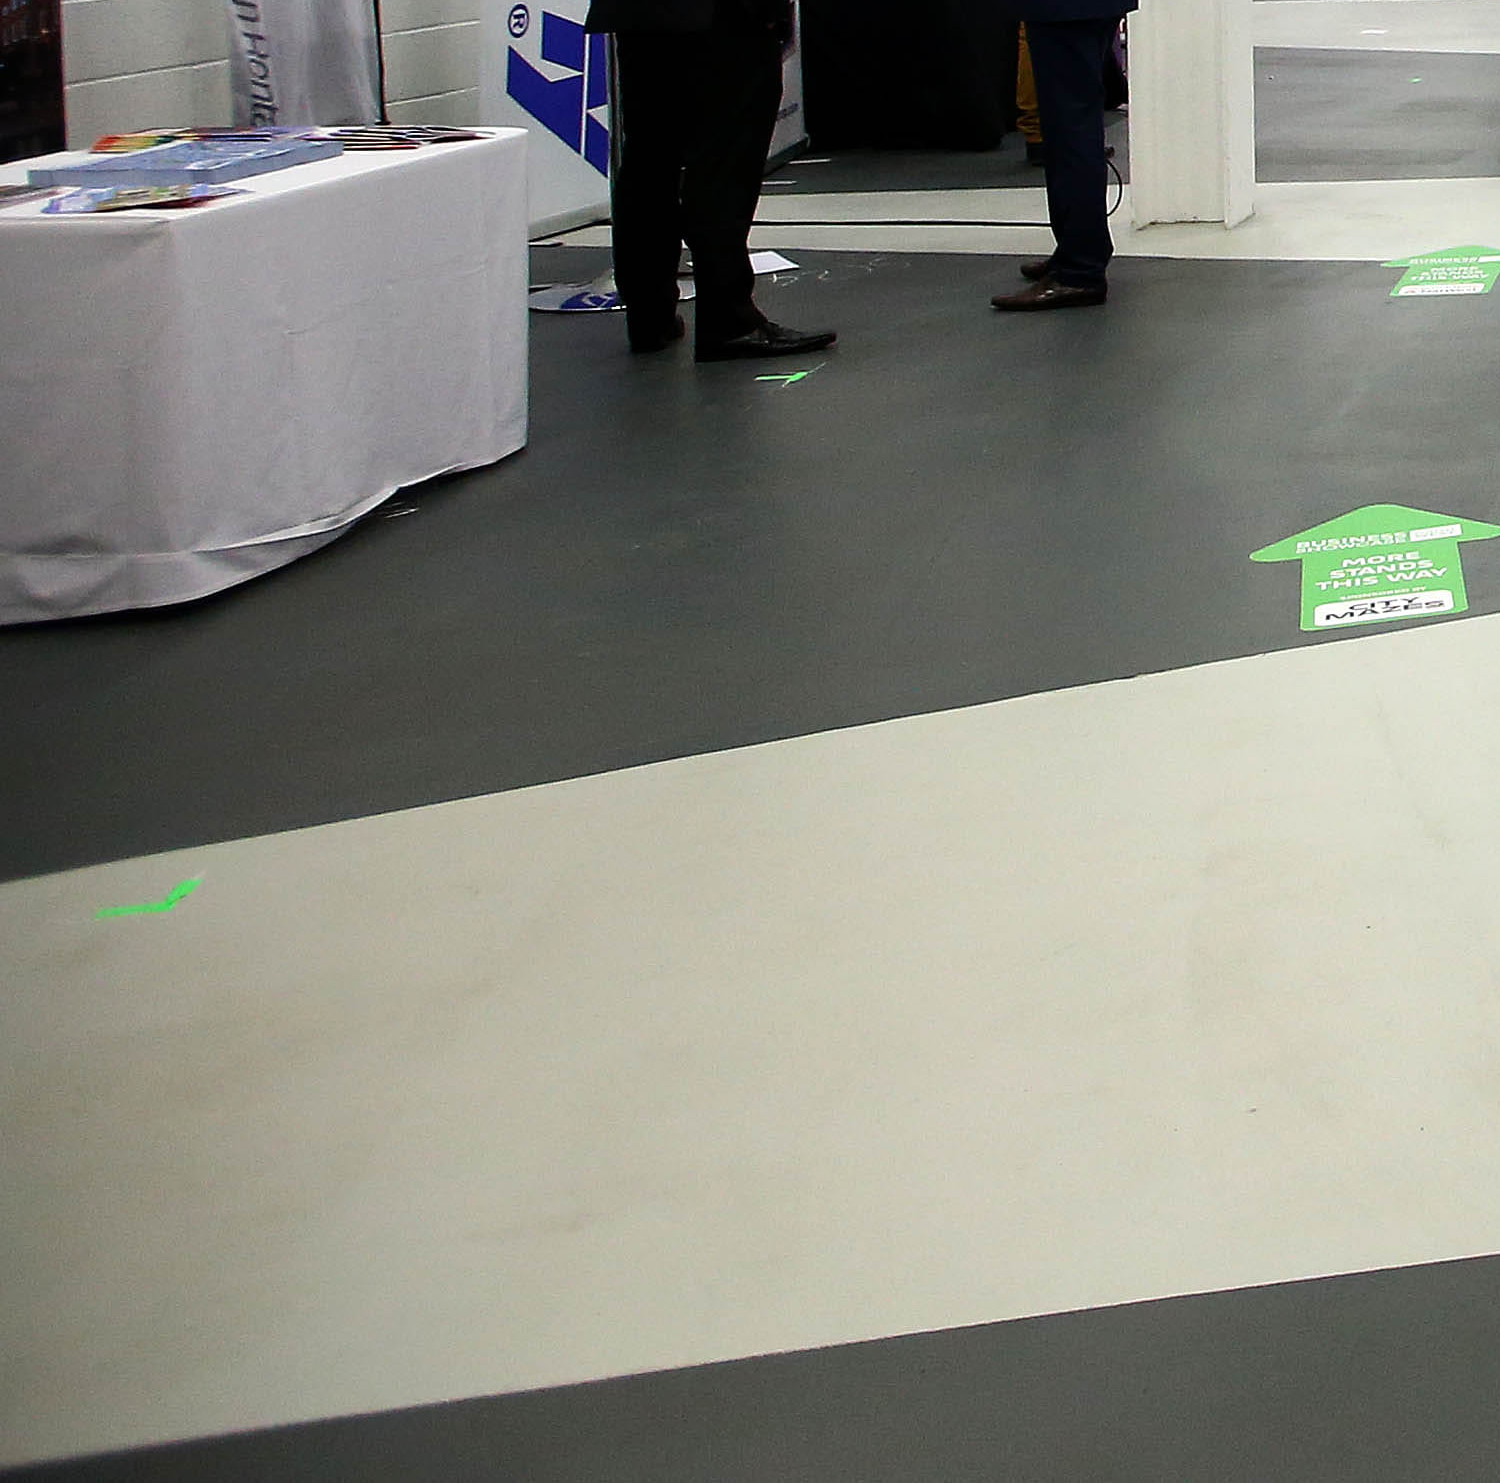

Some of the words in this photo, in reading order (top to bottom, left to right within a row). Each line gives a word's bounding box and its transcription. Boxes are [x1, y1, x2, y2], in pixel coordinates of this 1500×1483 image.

[1296, 532, 1408, 549] BUSINESS
[1341, 551, 1420, 567] MORE
[1329, 560, 1433, 580] STANDS
[1315, 577, 1379, 591] THIS
[1386, 568, 1449, 584] WAY
[1325, 600, 1446, 621] MAZES
[1349, 596, 1419, 611] CITY
